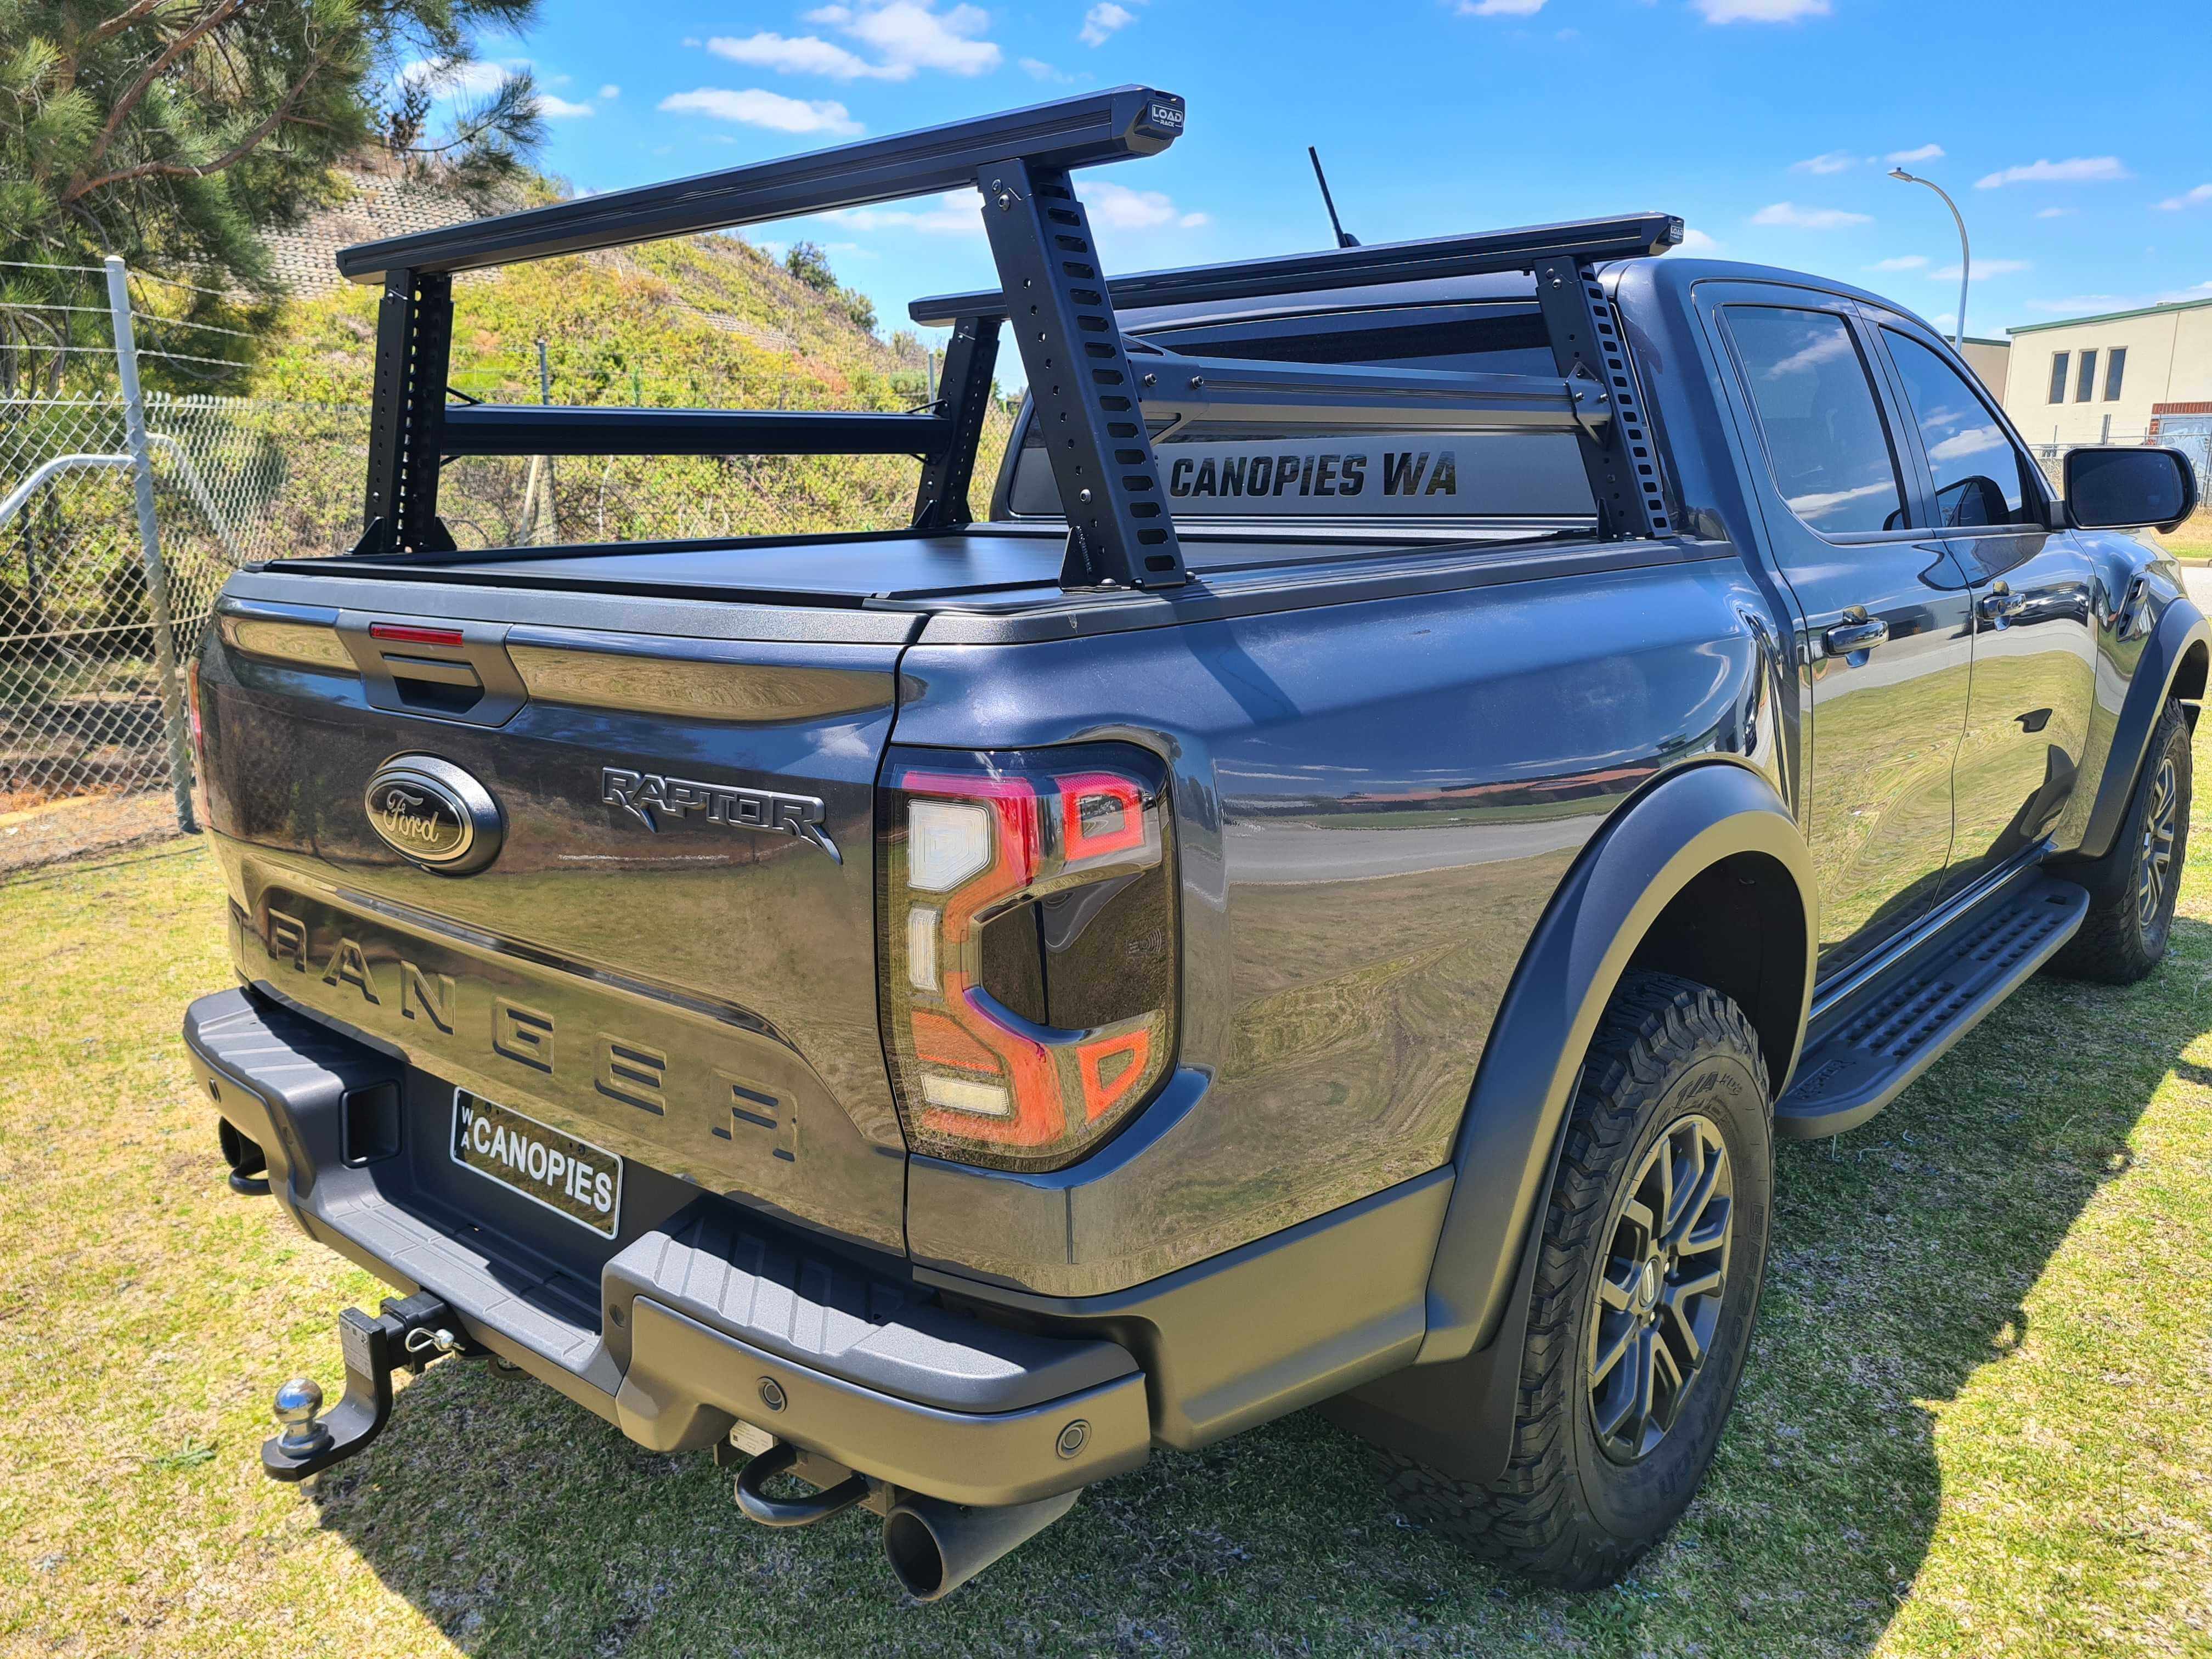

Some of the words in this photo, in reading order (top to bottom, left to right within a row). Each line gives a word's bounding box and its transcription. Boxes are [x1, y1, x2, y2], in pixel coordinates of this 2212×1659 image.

[1153, 108, 1181, 122] LOAD
[1160, 119, 1175, 127] RACK
[1170, 455, 1367, 497] CANOPIES
[1383, 451, 1457, 495] WA
[383, 789, 439, 842] Ford
[603, 766, 843, 866] RAPTOR
[268, 906, 799, 1163] RANGER
[473, 1116, 612, 1212] CANOPIES
